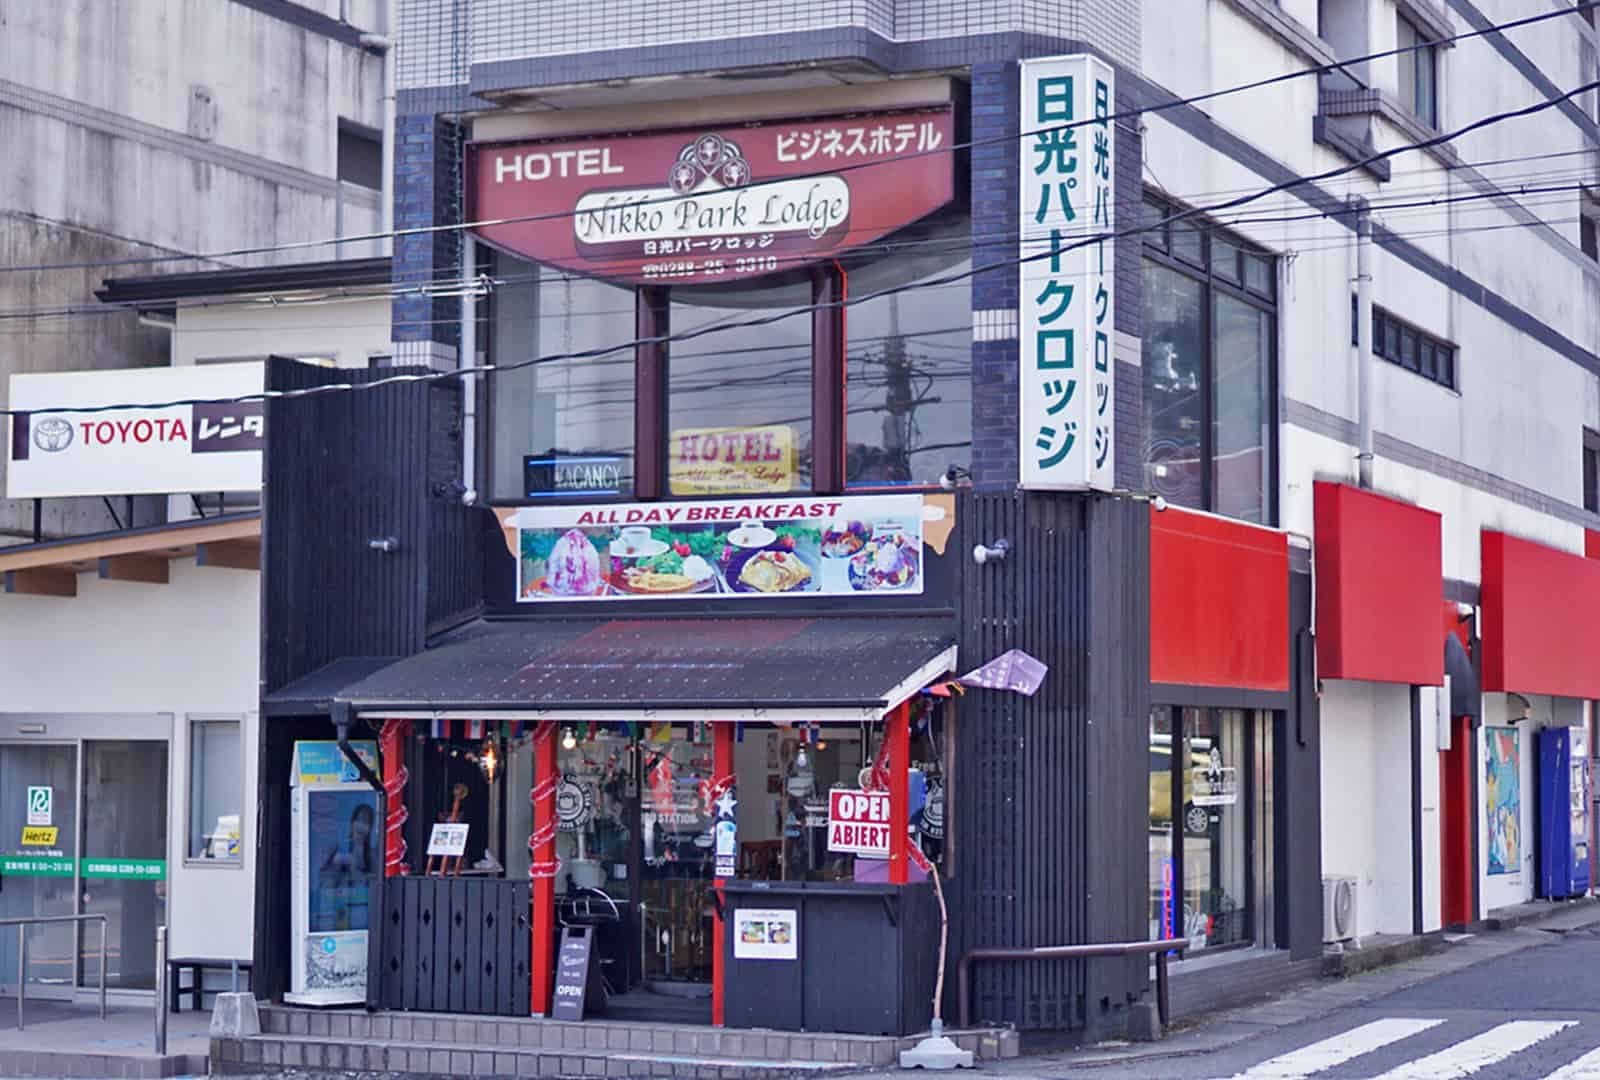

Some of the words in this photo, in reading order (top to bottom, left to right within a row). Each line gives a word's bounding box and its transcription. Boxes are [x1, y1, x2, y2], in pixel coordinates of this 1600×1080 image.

[776, 122, 942, 163] ビジネスホテル
[495, 148, 624, 184] HOTEL
[579, 194, 664, 237] Nikko
[673, 187, 748, 231] Park
[757, 181, 843, 239] Lodge
[643, 233, 775, 256] 日光パークロッジ
[1033, 76, 1078, 470] 日光パークロッジ
[1094, 79, 1110, 470] 日光パークロッジ
[80, 418, 188, 445] TOYOTA
[678, 433, 782, 464] HOTEL
[577, 510, 619, 525] ALL
[625, 507, 681, 524] DAY
[686, 503, 842, 521] BREAKFAST
[25, 831, 53, 843] Hertz
[832, 824, 890, 848] ABIERT
[557, 985, 582, 997] OPEN
